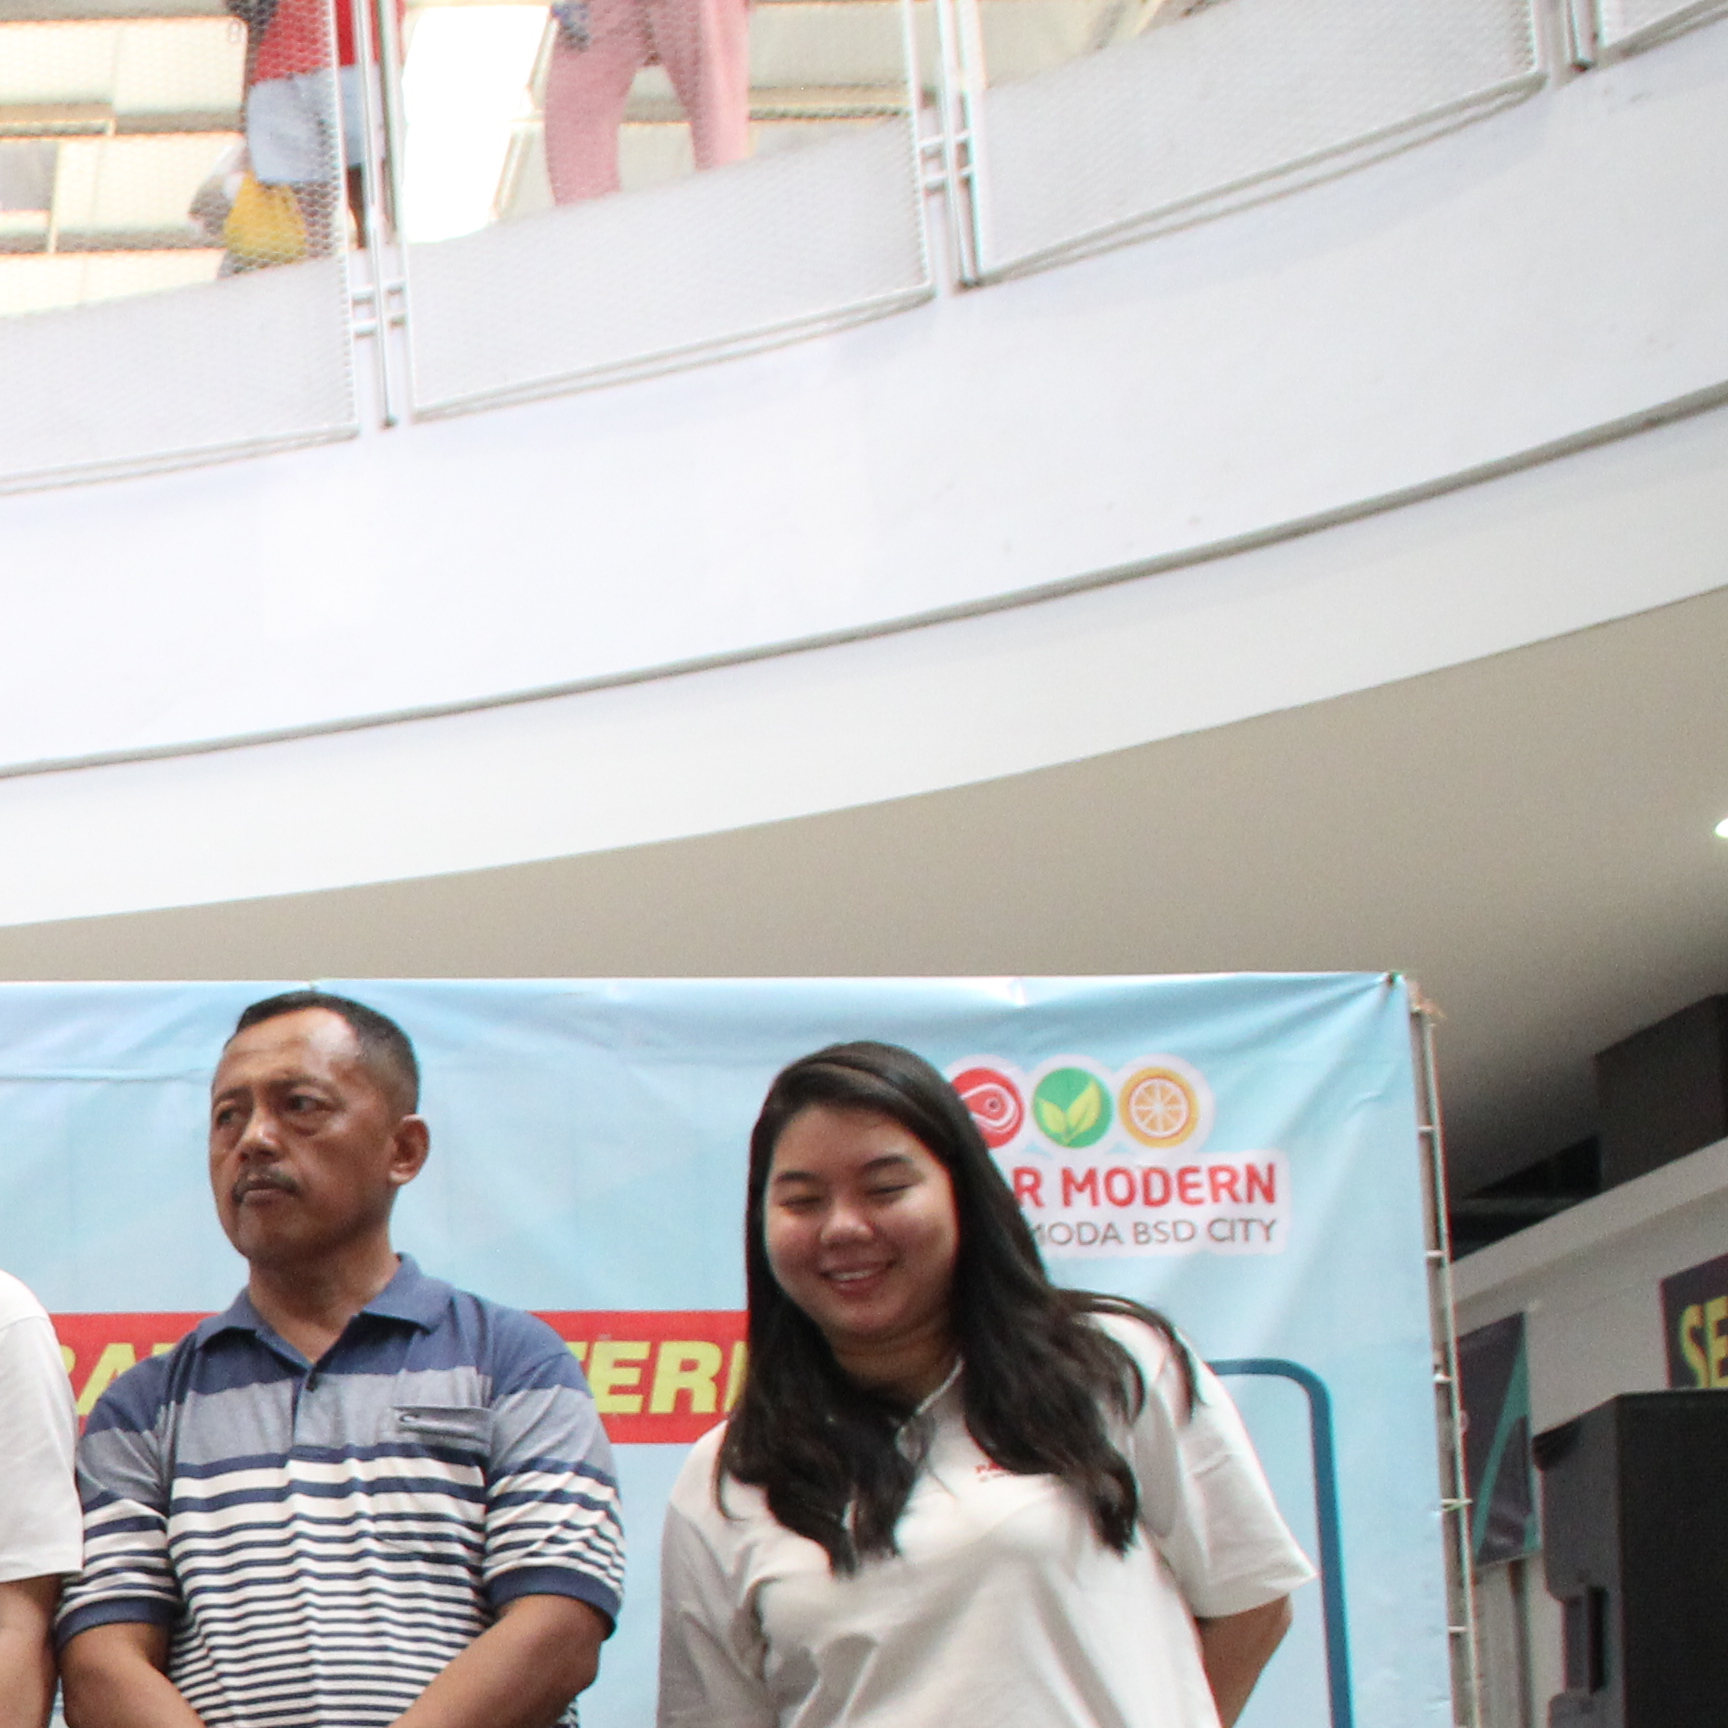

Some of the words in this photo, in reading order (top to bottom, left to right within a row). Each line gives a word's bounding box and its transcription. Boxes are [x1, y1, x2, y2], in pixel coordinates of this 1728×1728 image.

[1062, 1163, 1277, 1208] MODERN
[1133, 1220, 1196, 1246] BSD
[1208, 1217, 1277, 1244] CITY
